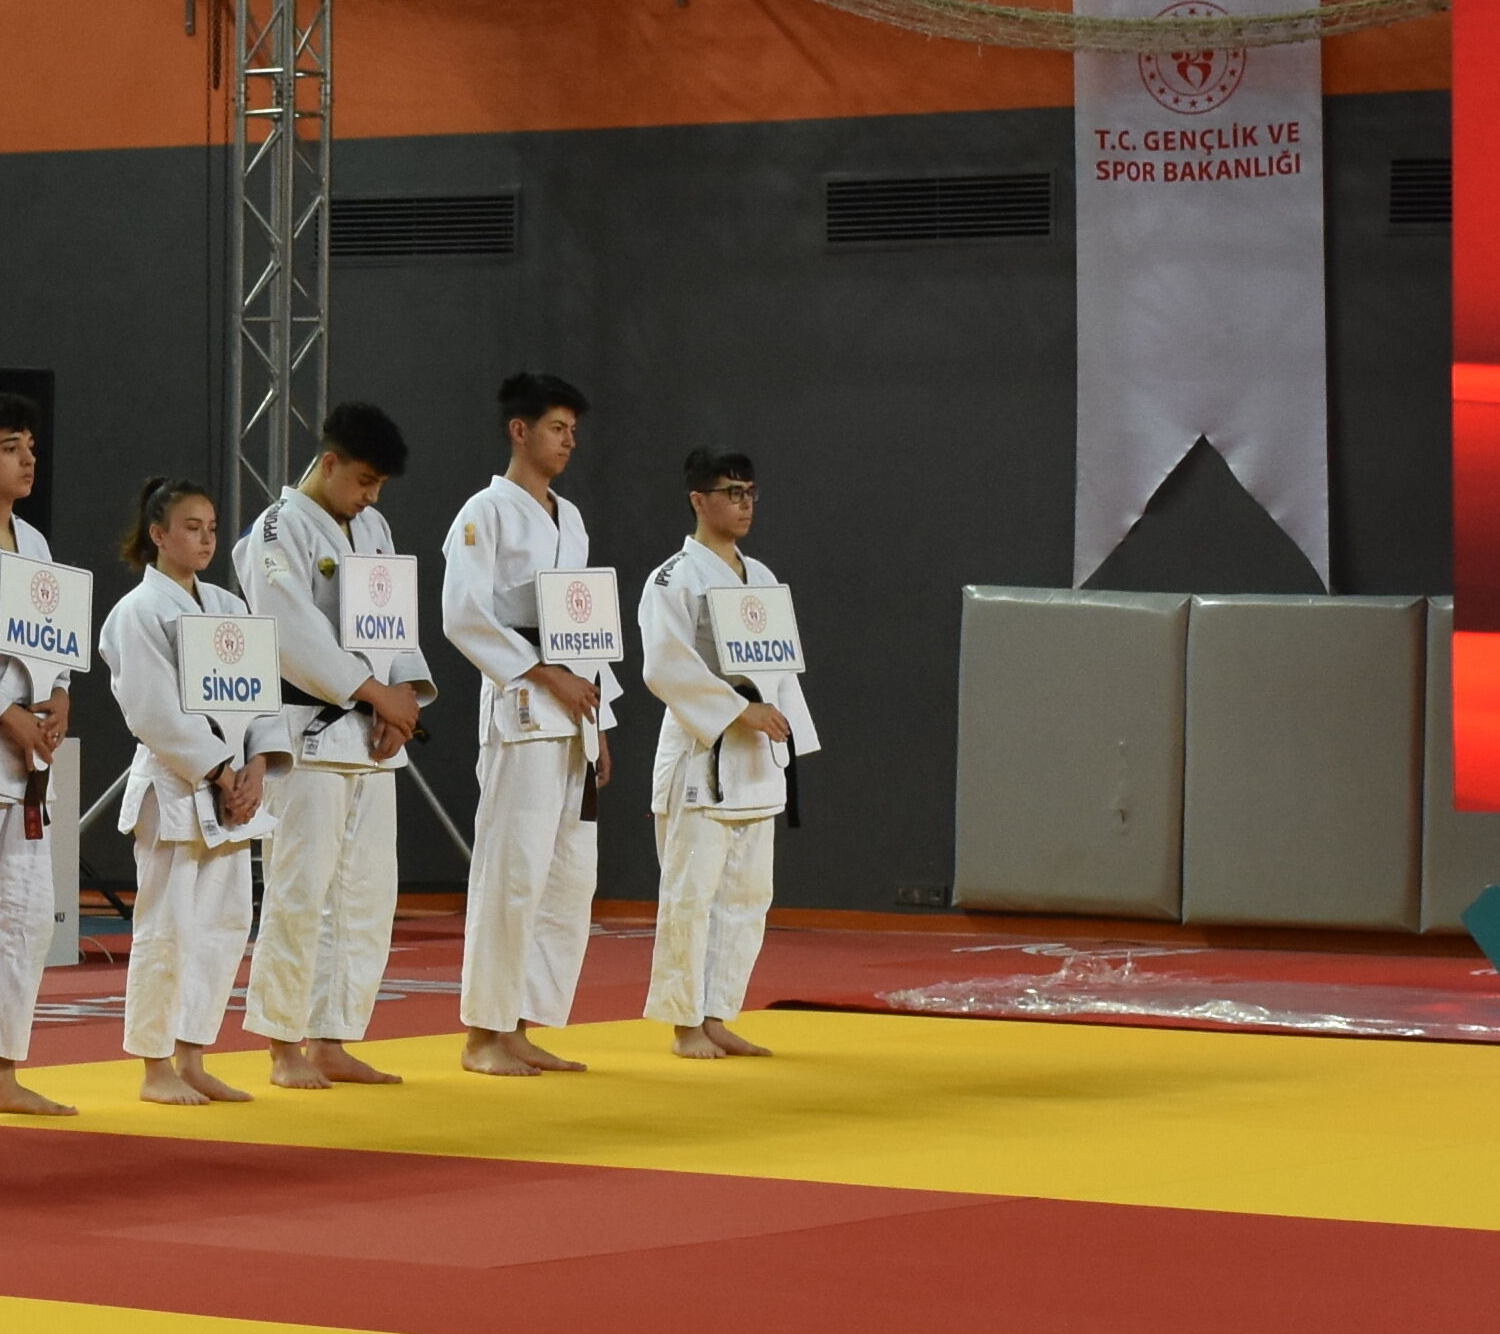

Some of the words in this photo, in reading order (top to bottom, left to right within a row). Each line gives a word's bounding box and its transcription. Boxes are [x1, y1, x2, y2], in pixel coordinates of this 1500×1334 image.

[1095, 129, 1137, 151] T.C.
[1143, 123, 1259, 156] GENÇLİK
[1267, 122, 1300, 144] VE
[1096, 160, 1155, 182] SPOR
[1163, 150, 1301, 182] BAKANLIĞI
[6, 618, 79, 658] MUĞLA
[356, 615, 405, 640] KONYA
[549, 629, 614, 655] KIRŞEHİR
[727, 640, 795, 662] TRABZON
[203, 669, 261, 702] SİNOP
